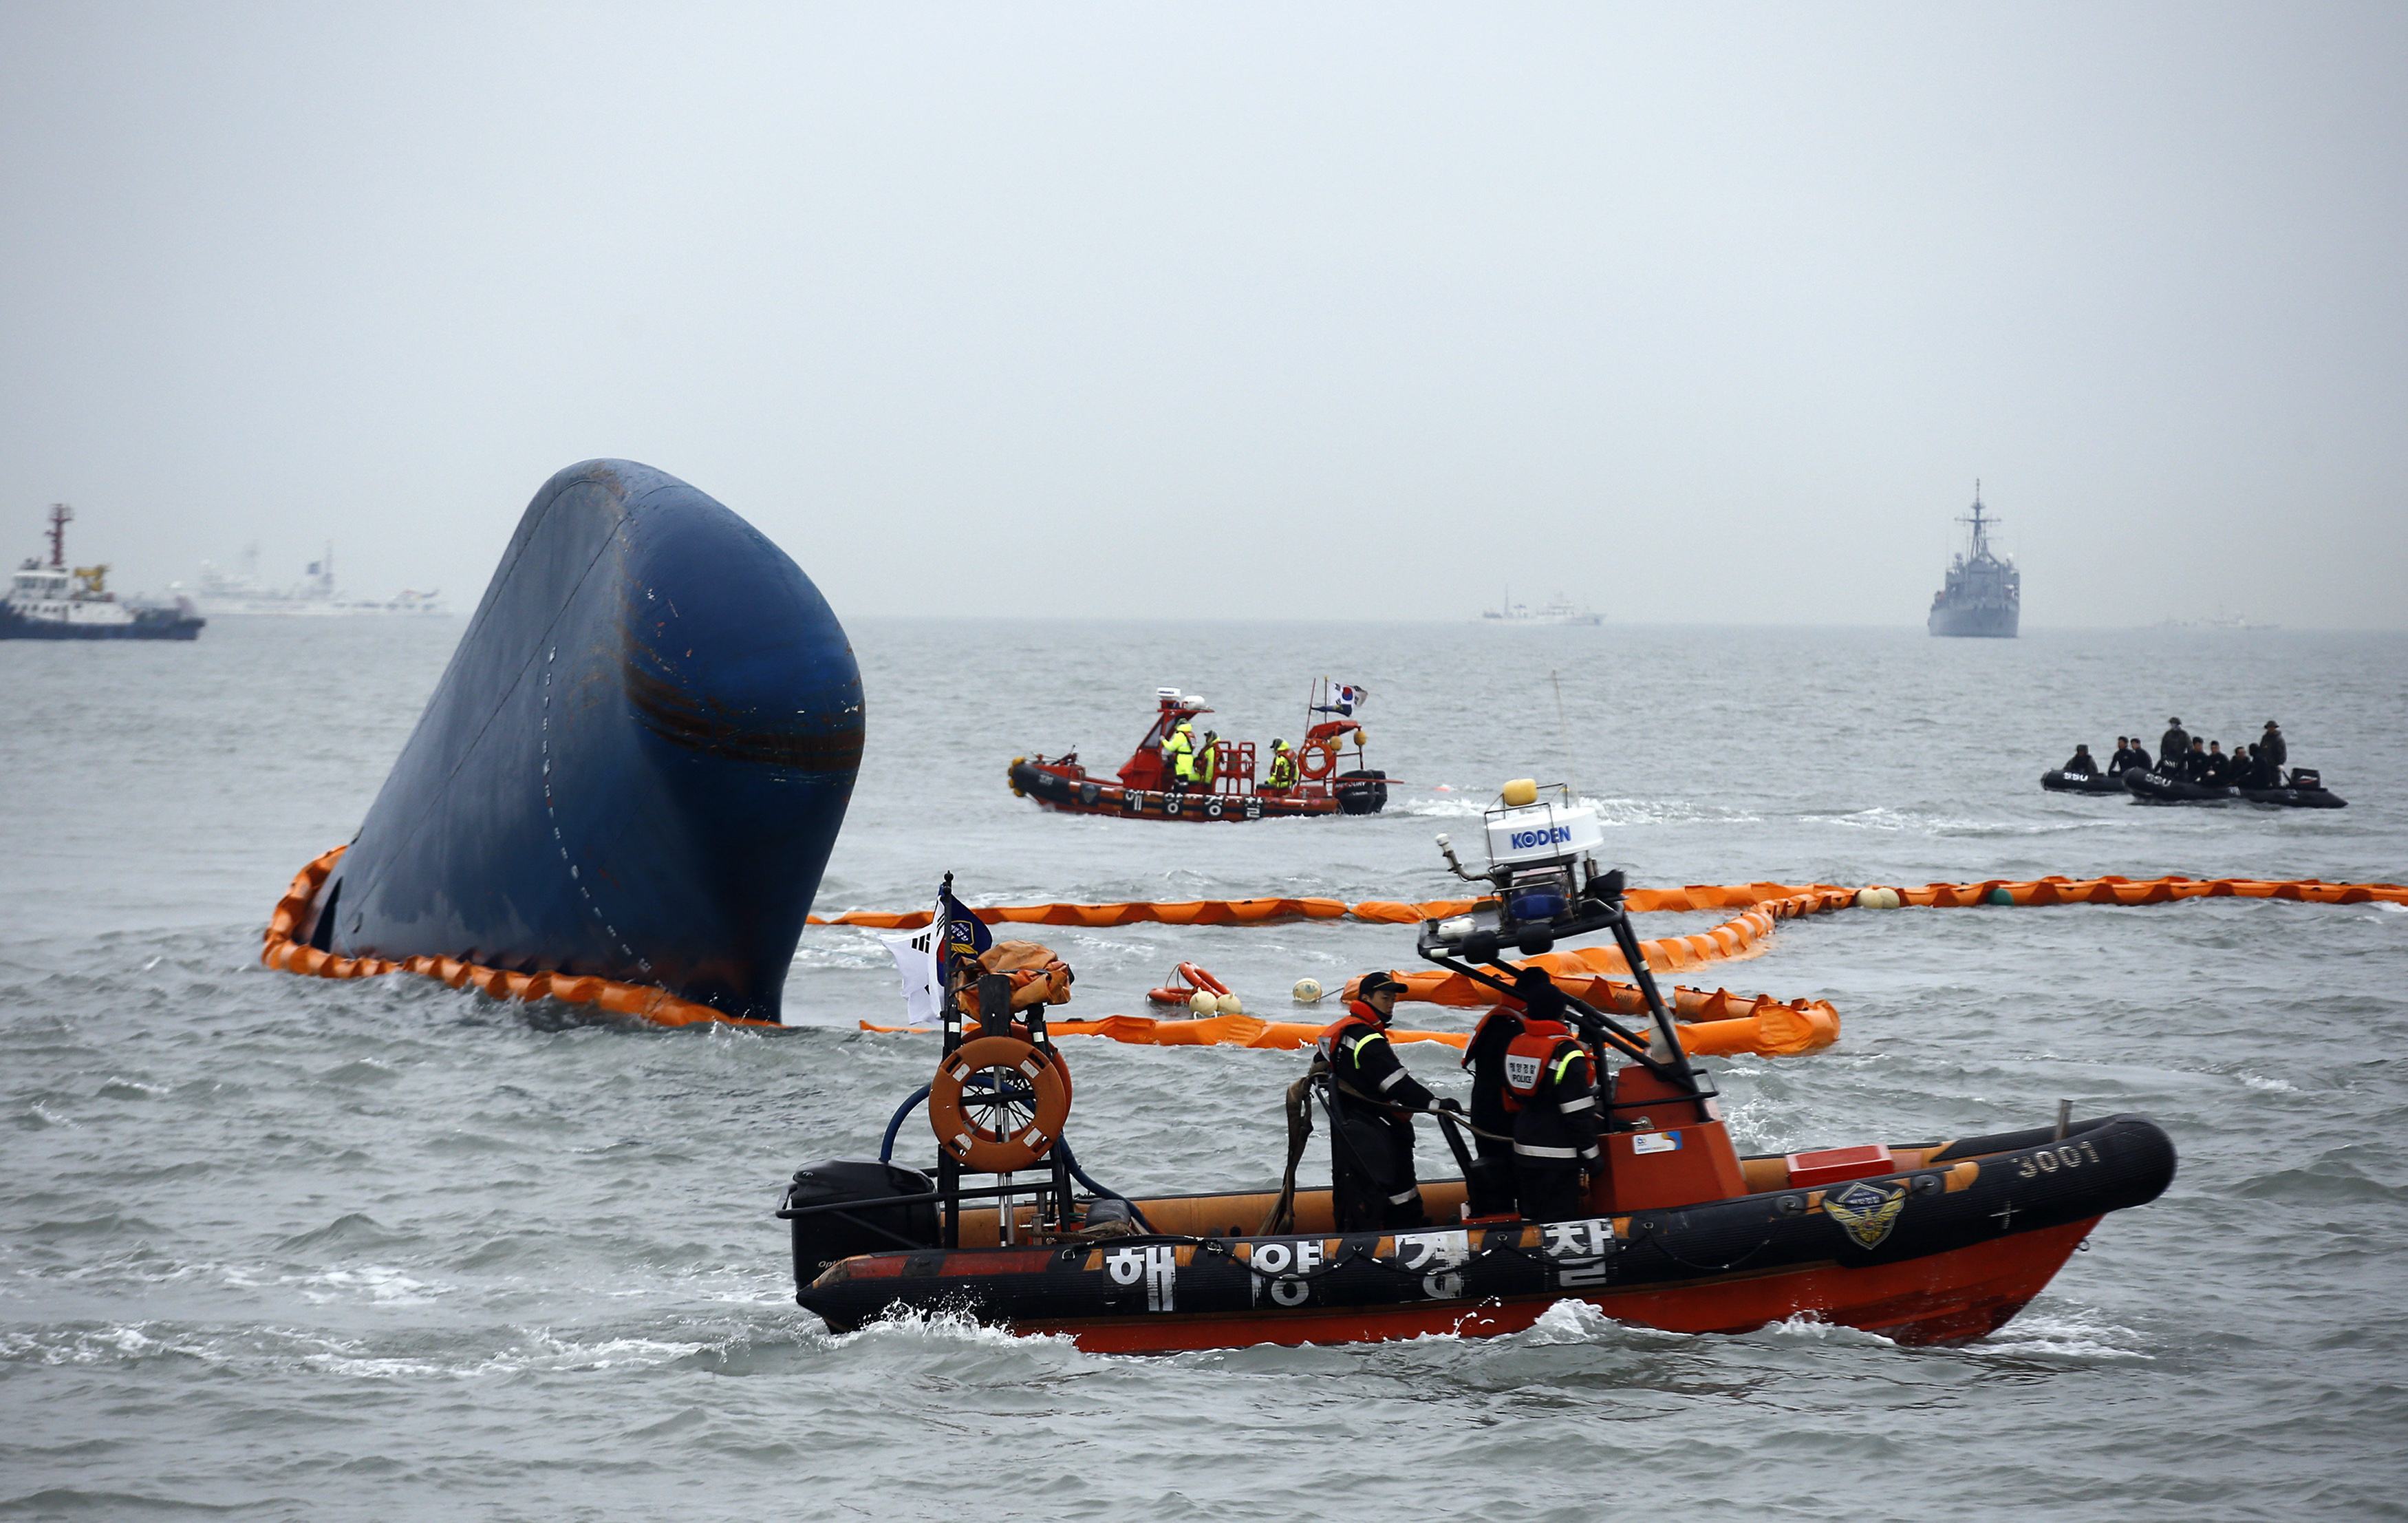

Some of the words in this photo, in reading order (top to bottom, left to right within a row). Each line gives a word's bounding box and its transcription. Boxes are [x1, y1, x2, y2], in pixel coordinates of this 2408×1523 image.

[1511, 825, 1571, 849] KODEN
[1512, 1074, 1532, 1083] POLICE
[2010, 1140, 2101, 1179] 3001
